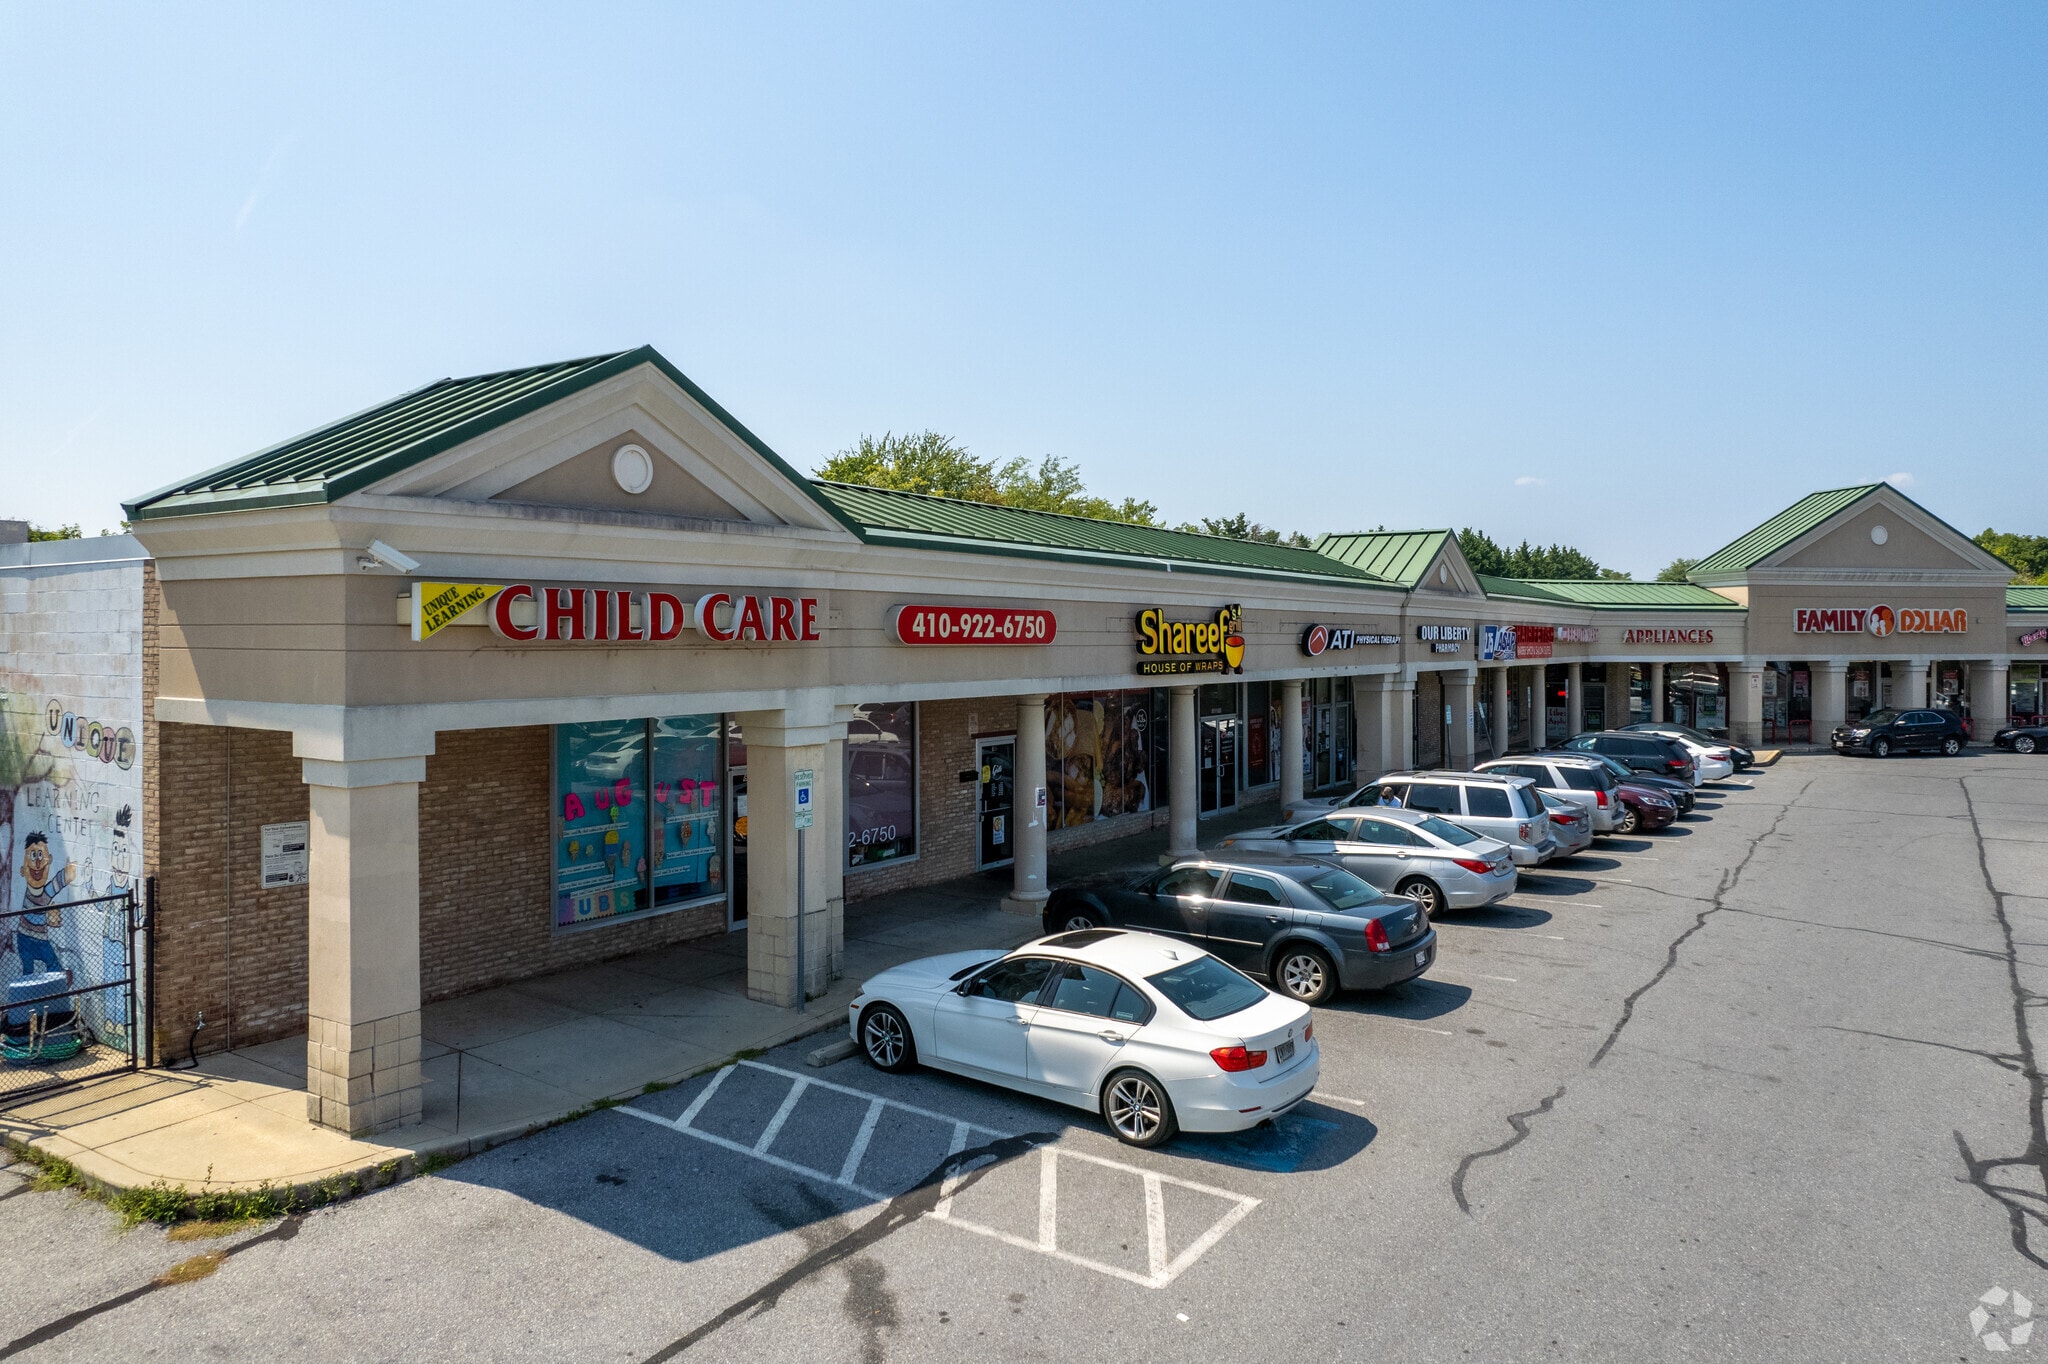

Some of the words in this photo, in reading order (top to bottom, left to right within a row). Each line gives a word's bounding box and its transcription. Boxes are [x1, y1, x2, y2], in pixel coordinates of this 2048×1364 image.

[423, 586, 460, 616] UNIQUE
[424, 587, 485, 632] LEARNING
[495, 584, 685, 641] CHILD
[702, 592, 821, 641] CARE
[912, 612, 1046, 639] 410-922-6750
[1797, 609, 1867, 632] FAMILY
[1900, 609, 1967, 632] DOLLAR
[1330, 630, 1355, 650] ATI
[1356, 635, 1380, 645] PHYSICAL
[1380, 634, 1402, 645] THERAPY
[1421, 625, 1439, 640] OUR
[1440, 626, 1471, 641] LIBERTY
[1497, 631, 1516, 651] ASAP
[1625, 629, 1714, 644] APPLIANCES
[1435, 643, 1460, 653] PHARMACY
[1143, 662, 1177, 673] HOUSE
[1180, 662, 1192, 672] OF
[1195, 661, 1223, 671] WRAPS
[48, 708, 132, 764] UNIQUE
[26, 786, 100, 814] LEARNING
